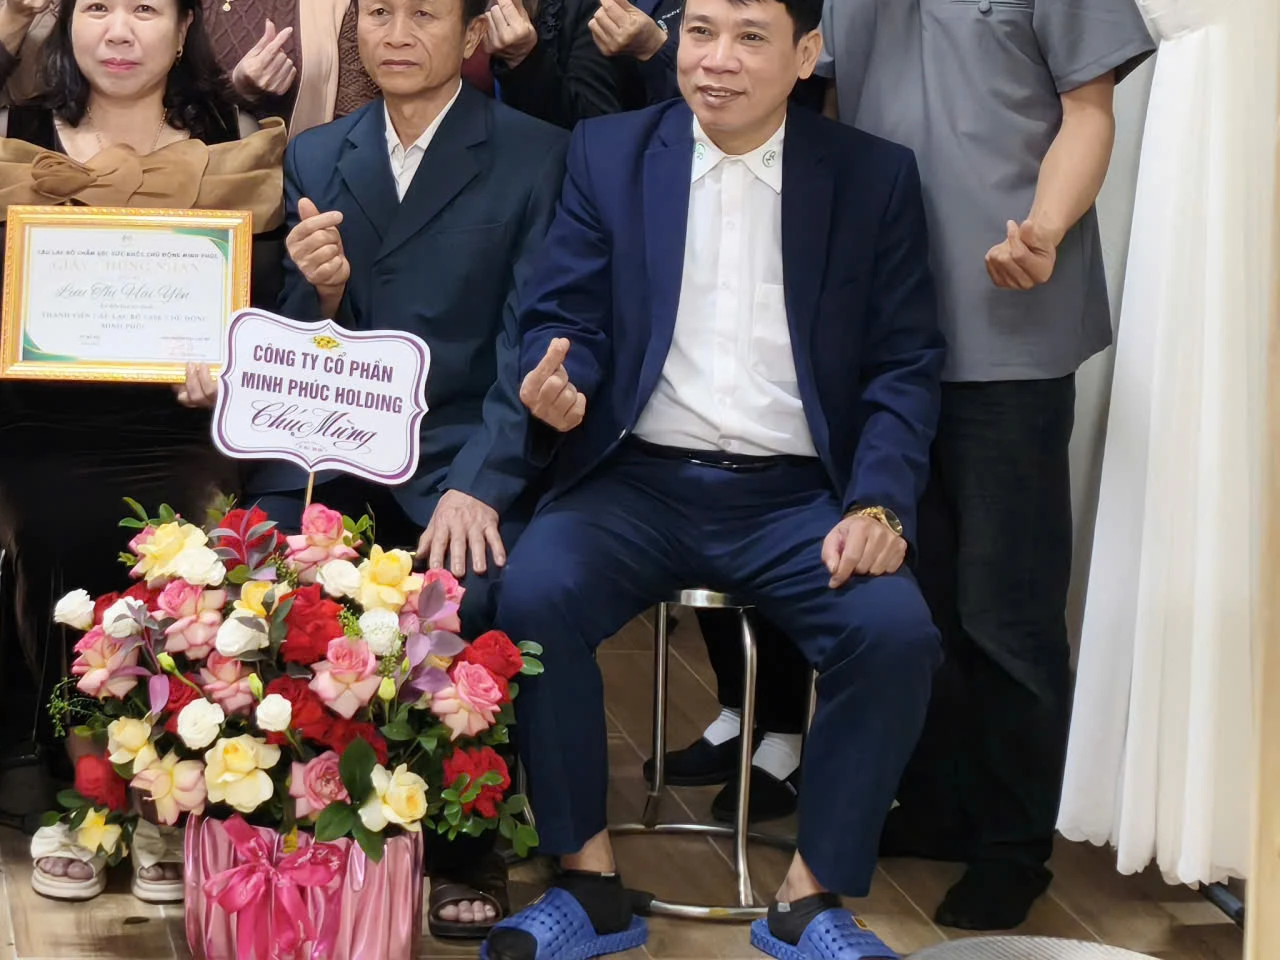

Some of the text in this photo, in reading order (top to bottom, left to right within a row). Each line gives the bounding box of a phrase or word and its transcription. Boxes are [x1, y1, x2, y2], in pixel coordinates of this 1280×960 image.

[253, 342, 296, 367] CÔNG
[301, 352, 319, 371] TY
[323, 352, 347, 375] CỔ
[241, 371, 403, 414] MINH PHÚC HOLDING
[251, 400, 377, 452] Chúc Mừng
